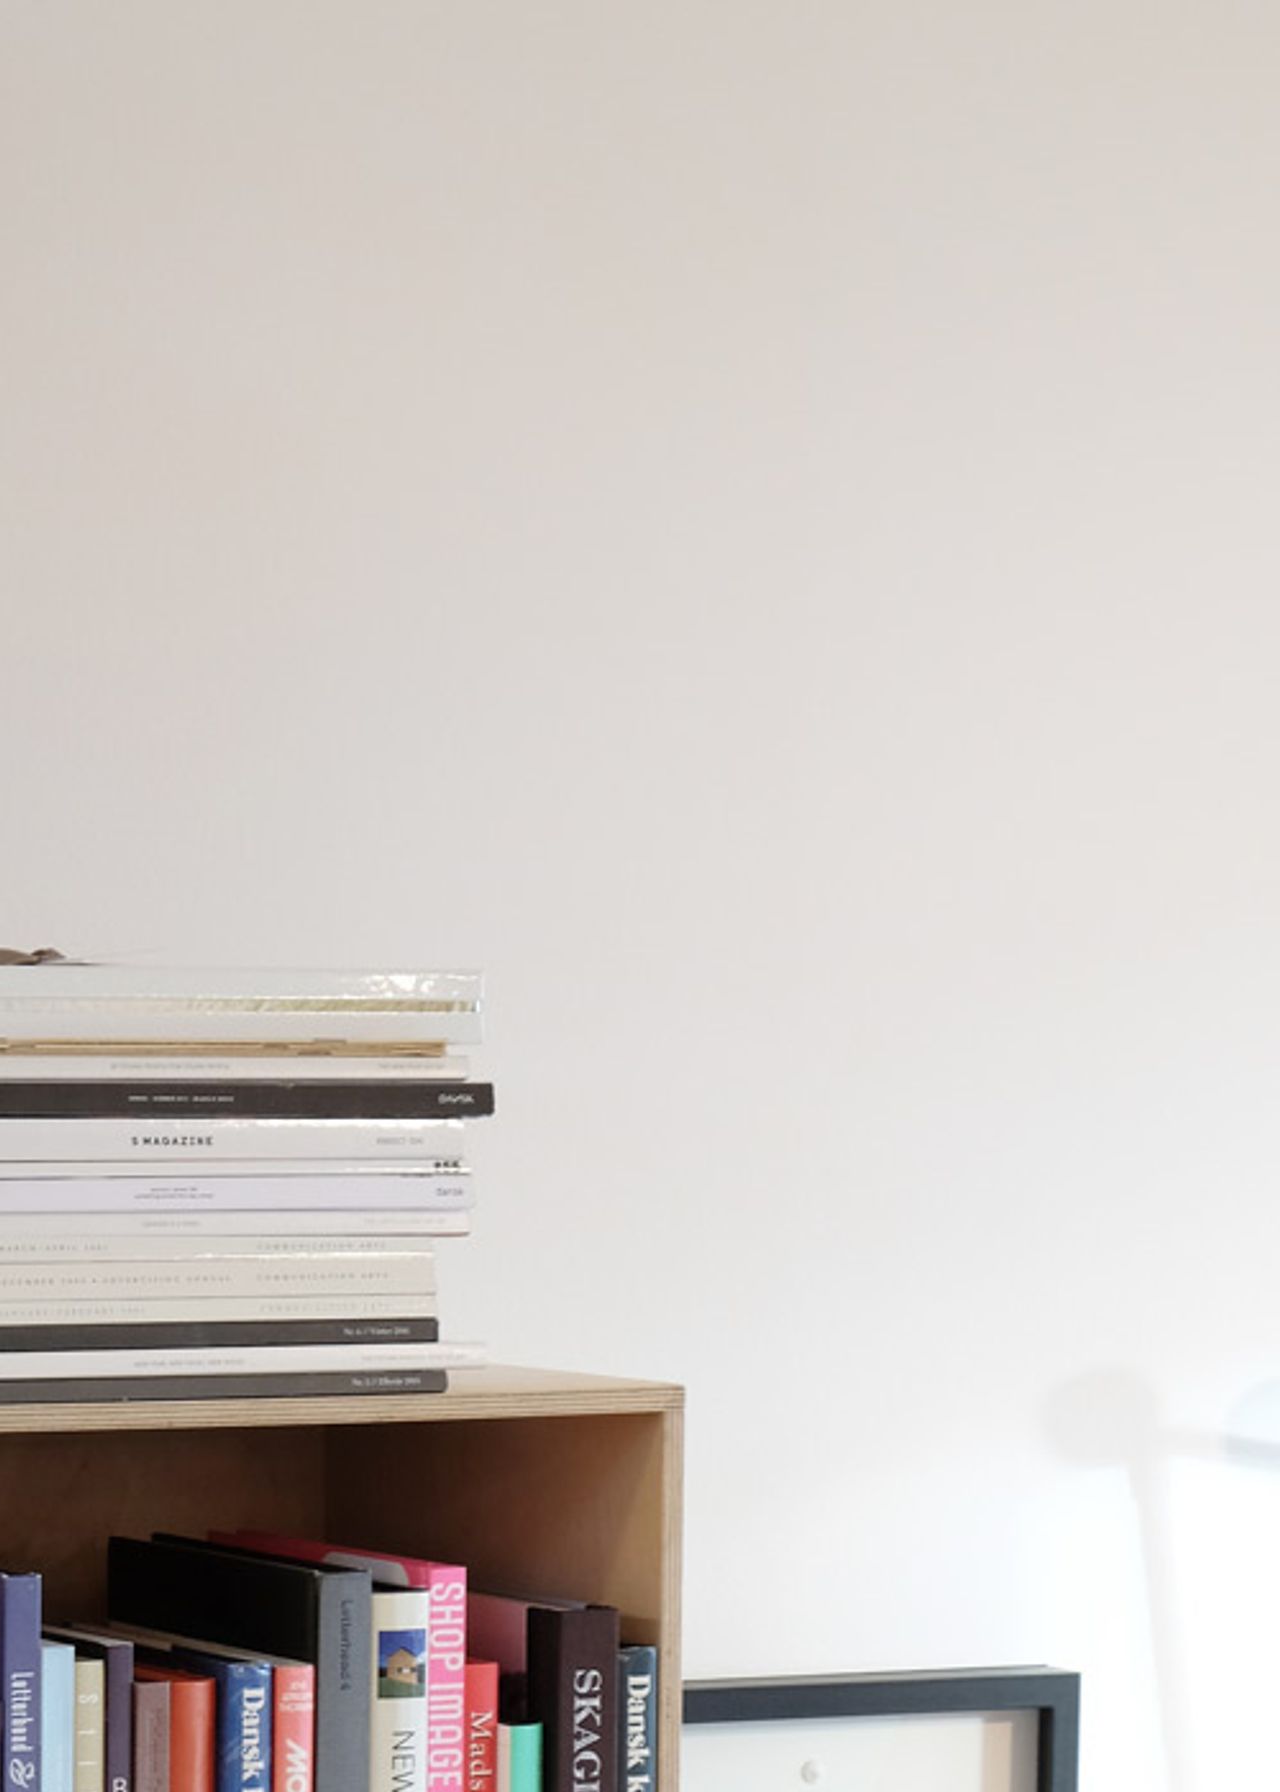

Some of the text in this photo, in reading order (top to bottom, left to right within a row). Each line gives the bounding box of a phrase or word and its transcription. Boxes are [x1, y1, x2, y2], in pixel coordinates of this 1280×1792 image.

[143, 1136, 213, 1146] MAGAZINE
[429, 1581, 464, 1671] SHOP
[240, 1687, 266, 1781] Dansk
[427, 1683, 463, 1787] IMAGE
[469, 1712, 493, 1791] Mads
[625, 1675, 652, 1769] Dansk
